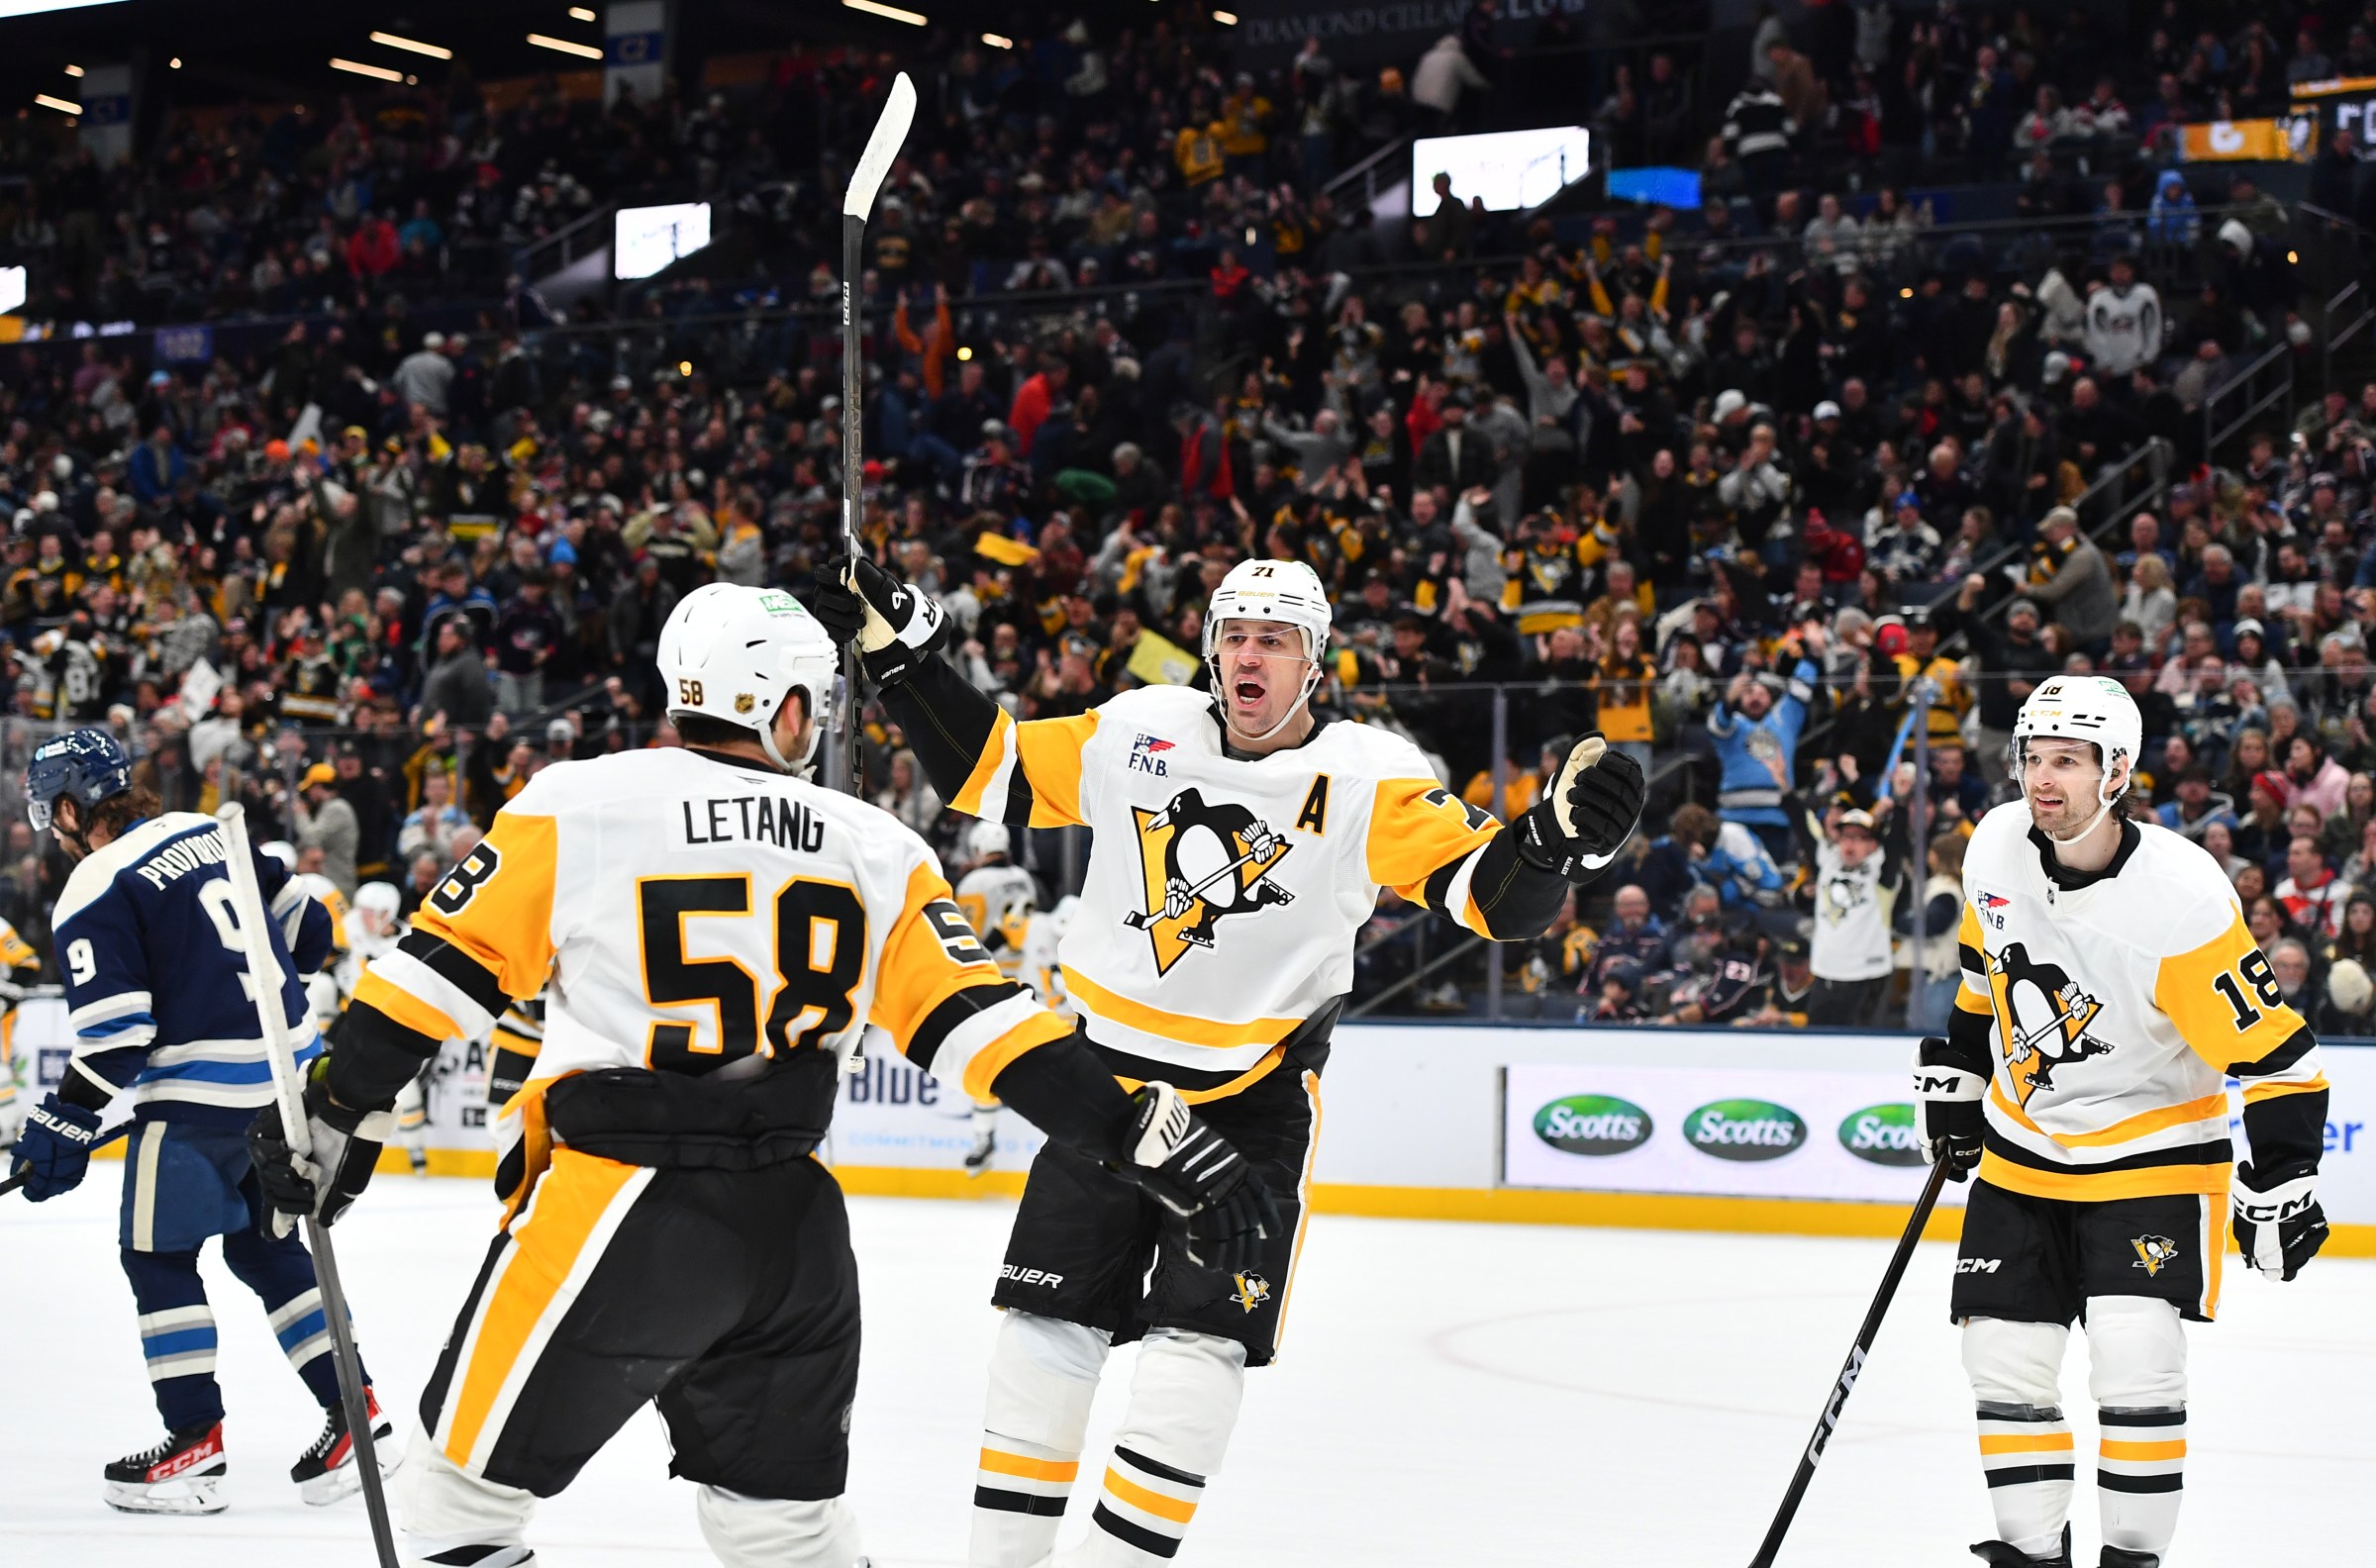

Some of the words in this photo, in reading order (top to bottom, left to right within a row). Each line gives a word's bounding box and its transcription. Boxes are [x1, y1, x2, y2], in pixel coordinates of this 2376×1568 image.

[1251, 567, 1274, 577] 71
[678, 678, 704, 707] 58
[2041, 685, 2063, 695] 18
[1129, 752, 1168, 778] F.N.B.
[1294, 772, 1332, 837] A
[683, 796, 825, 853] LETANG
[137, 828, 227, 891] PROVORO
[66, 937, 97, 988] 9
[635, 871, 868, 1076] 58
[2212, 947, 2284, 1033] 18
[1544, 1106, 1641, 1141] Scotts
[1695, 1110, 1794, 1146] Scotts
[1956, 1258, 2003, 1273] CM
[1808, 1344, 1867, 1467] CCM
[150, 1441, 213, 1481] CCM
[316, 1432, 337, 1459] CCM
